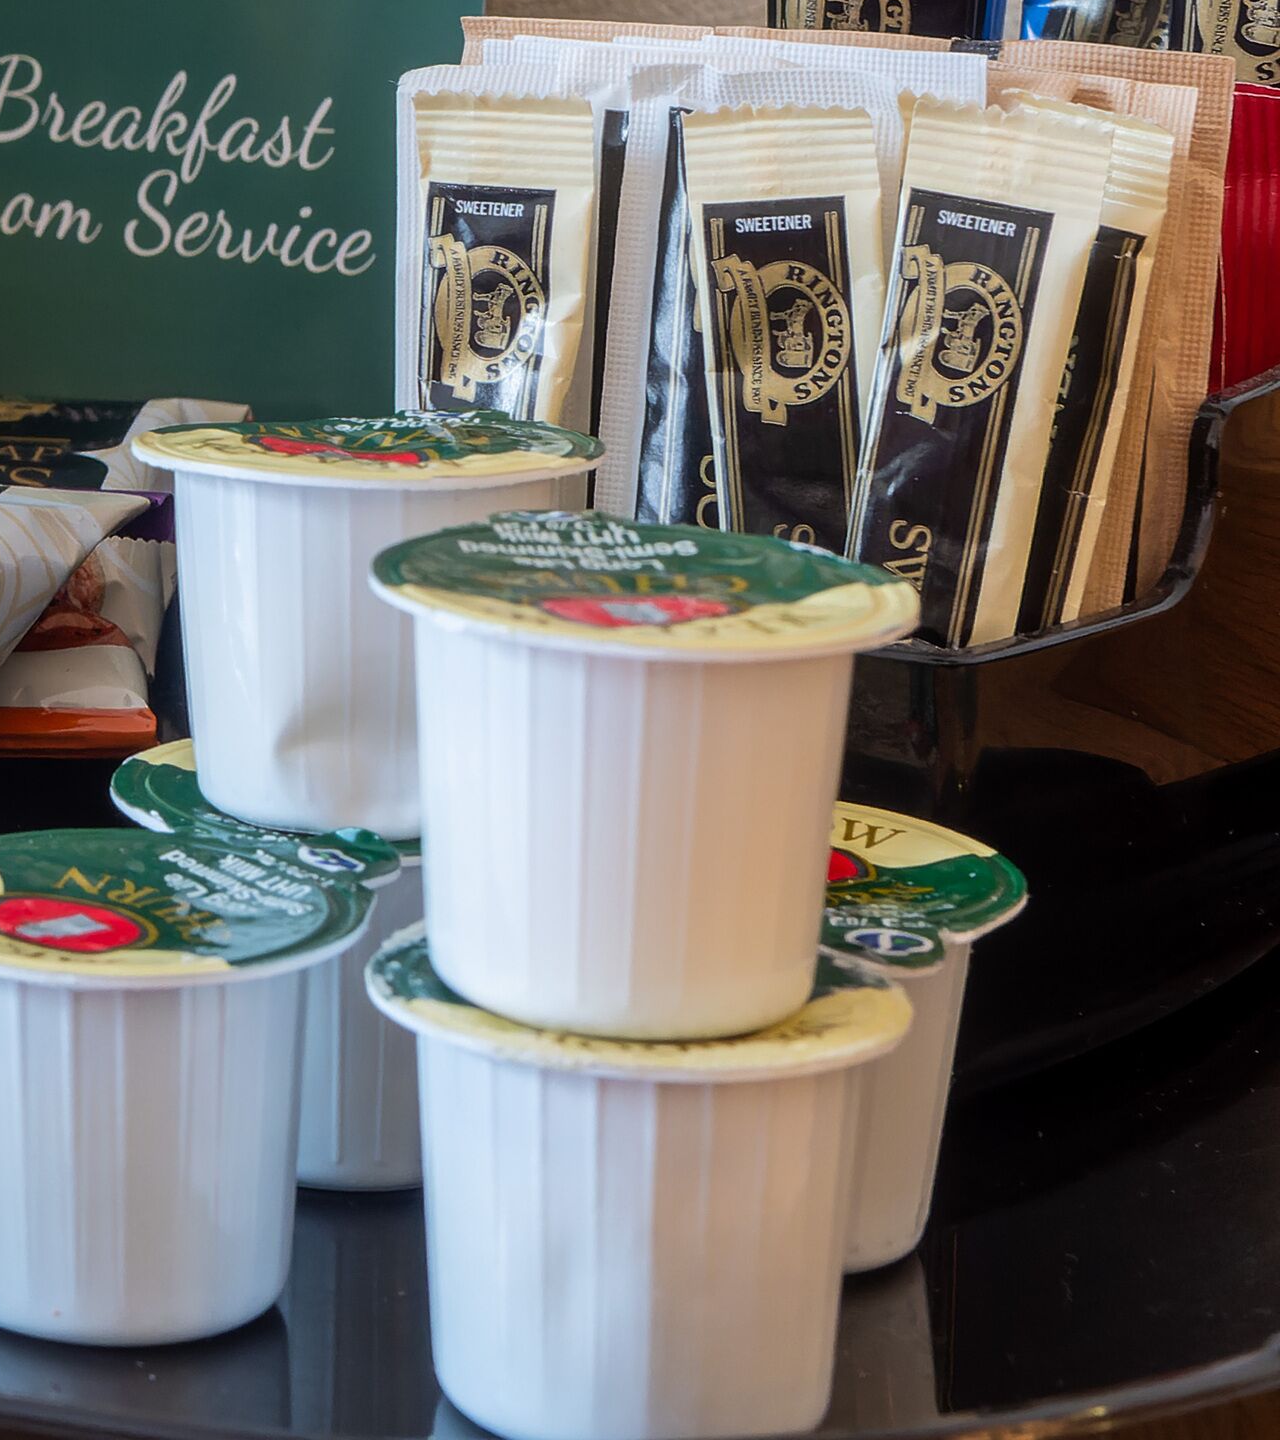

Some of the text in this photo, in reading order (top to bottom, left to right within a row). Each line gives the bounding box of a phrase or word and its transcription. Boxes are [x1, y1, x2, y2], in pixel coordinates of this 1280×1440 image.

[124, 169, 377, 277] Service
[454, 199, 525, 218] SWEETENER
[735, 214, 813, 234] SWEETENER
[937, 209, 1017, 238] SWEETENER
[785, 264, 845, 400] RINGTONS
[948, 267, 1017, 403] RINGTONS
